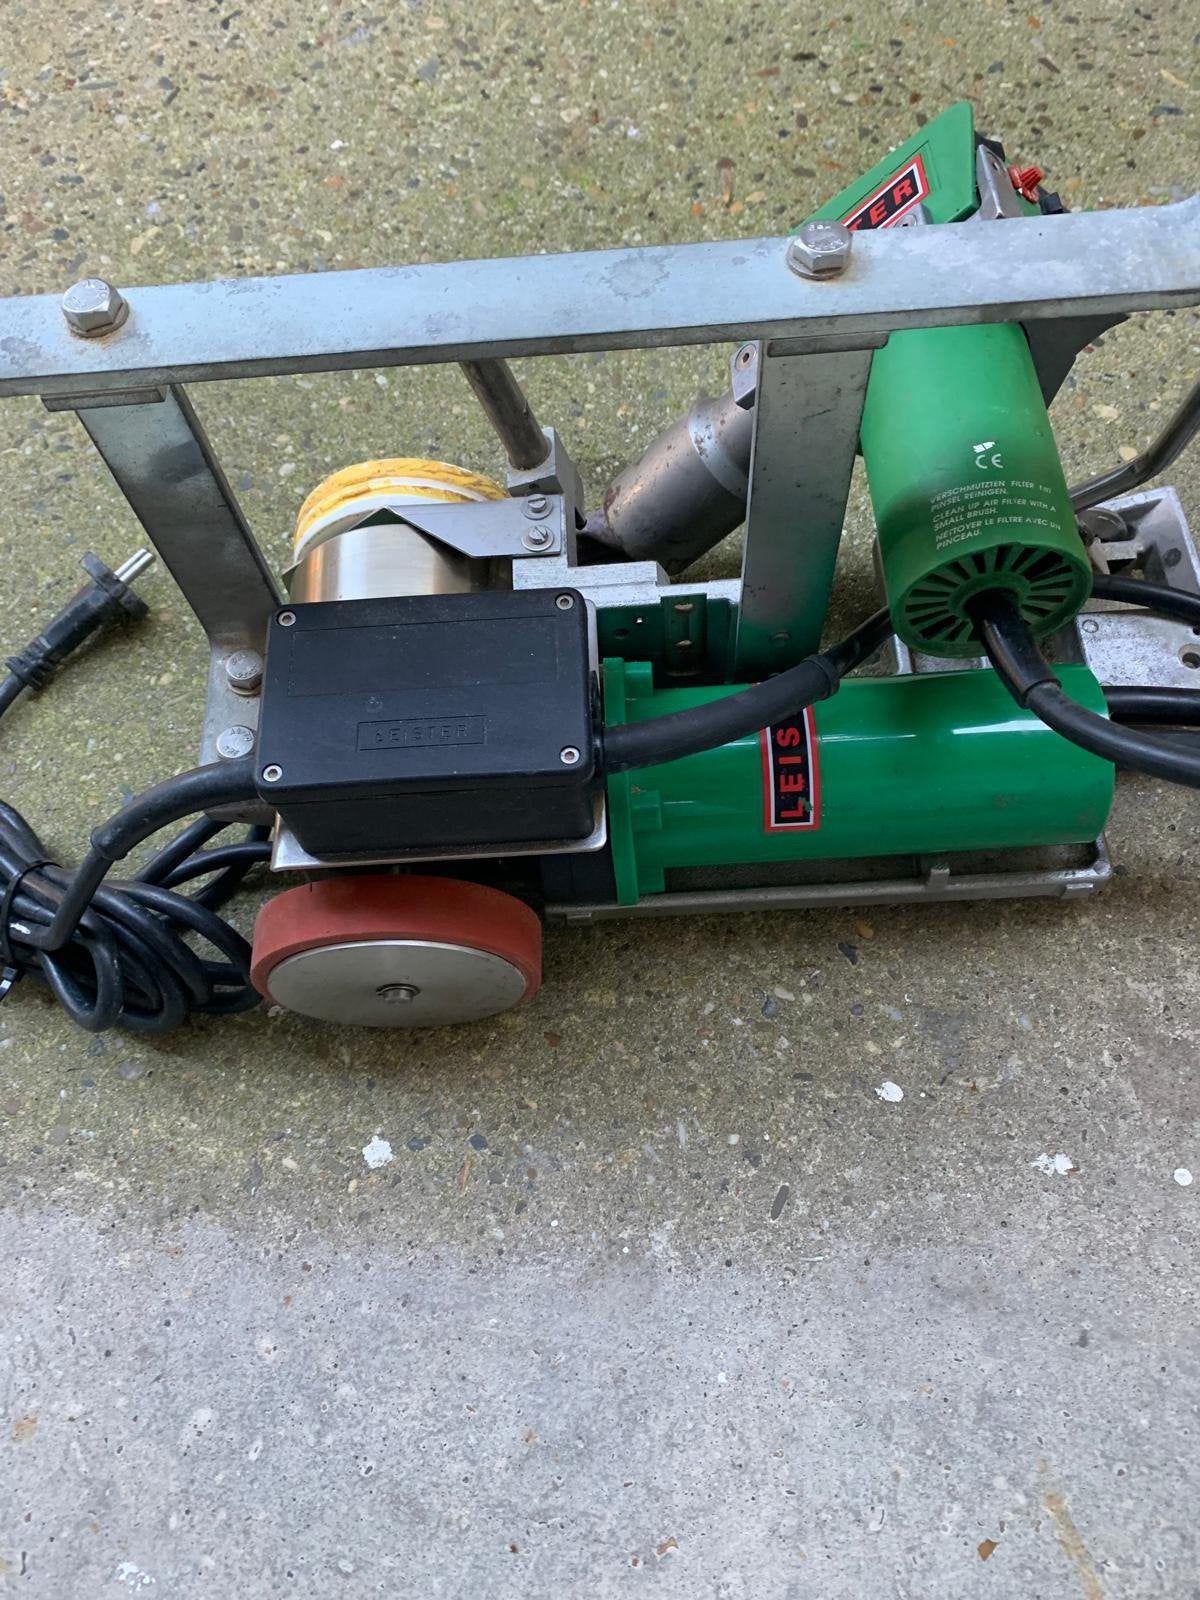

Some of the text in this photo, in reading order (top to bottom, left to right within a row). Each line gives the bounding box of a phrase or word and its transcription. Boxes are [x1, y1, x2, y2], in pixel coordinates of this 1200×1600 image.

[1011, 480, 1034, 489] FILTER
[931, 495, 961, 513] PINSEL
[933, 505, 965, 523] CLEAN
[968, 502, 980, 510] UP
[983, 499, 999, 508] AIR
[1050, 505, 1057, 513] A
[934, 514, 964, 532] SMALL
[984, 518, 995, 526] LE
[997, 516, 1024, 524] FILTRE
